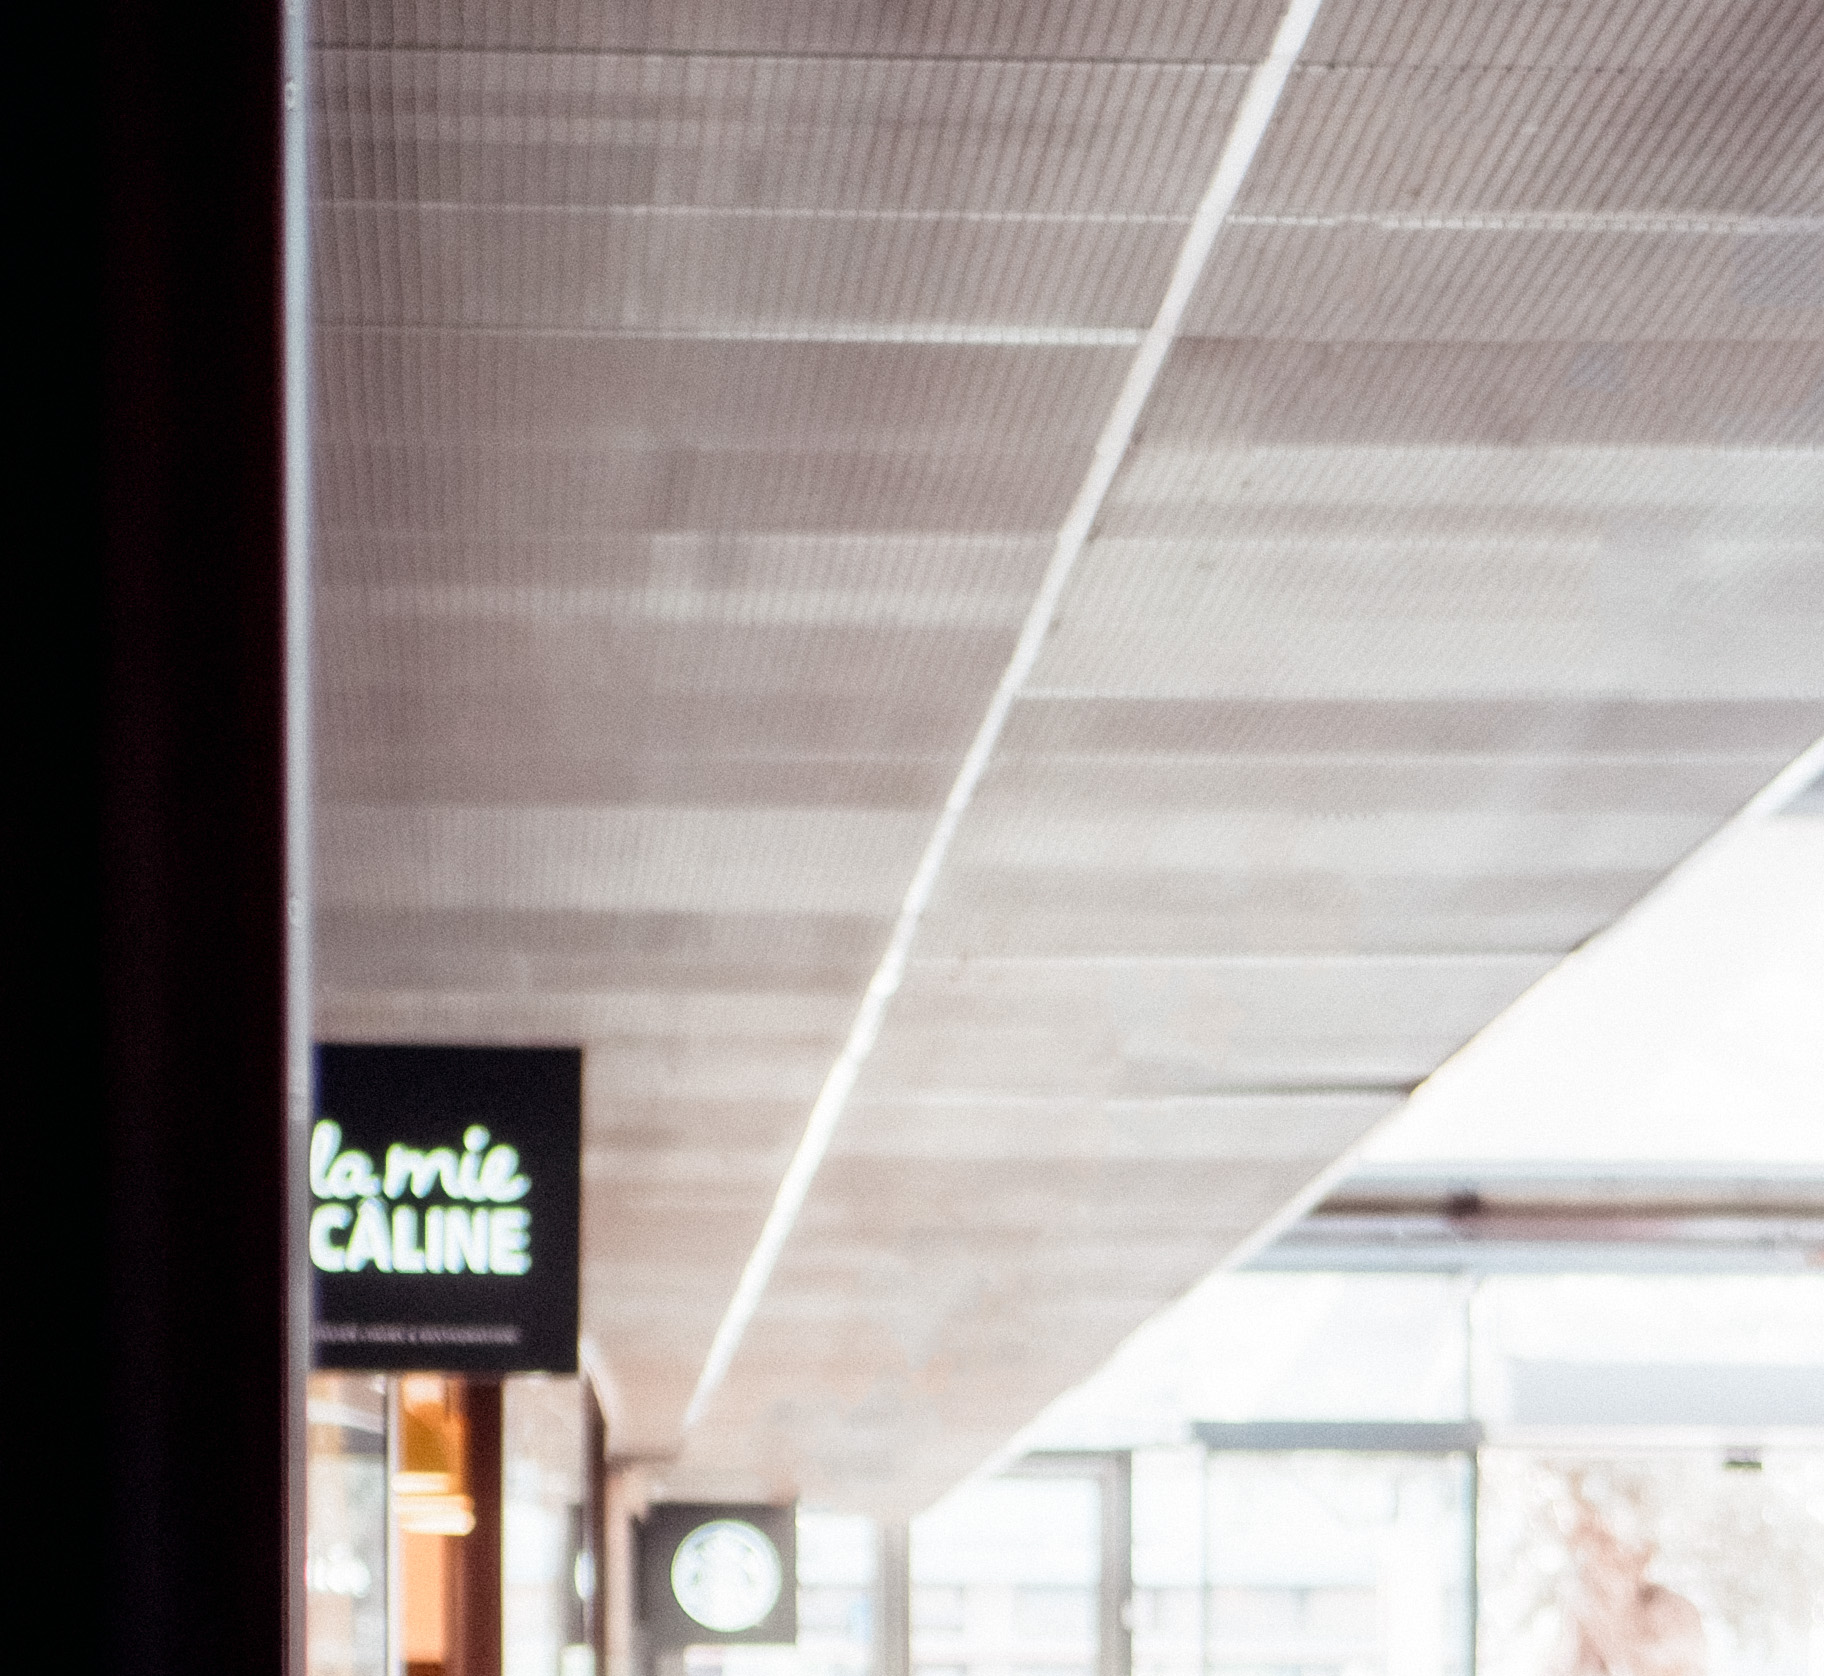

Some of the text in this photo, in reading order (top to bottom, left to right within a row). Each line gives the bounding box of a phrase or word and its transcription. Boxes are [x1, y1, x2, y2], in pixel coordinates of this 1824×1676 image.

[310, 1119, 532, 1202] la mie
[309, 1196, 533, 1275] CÂLINE
